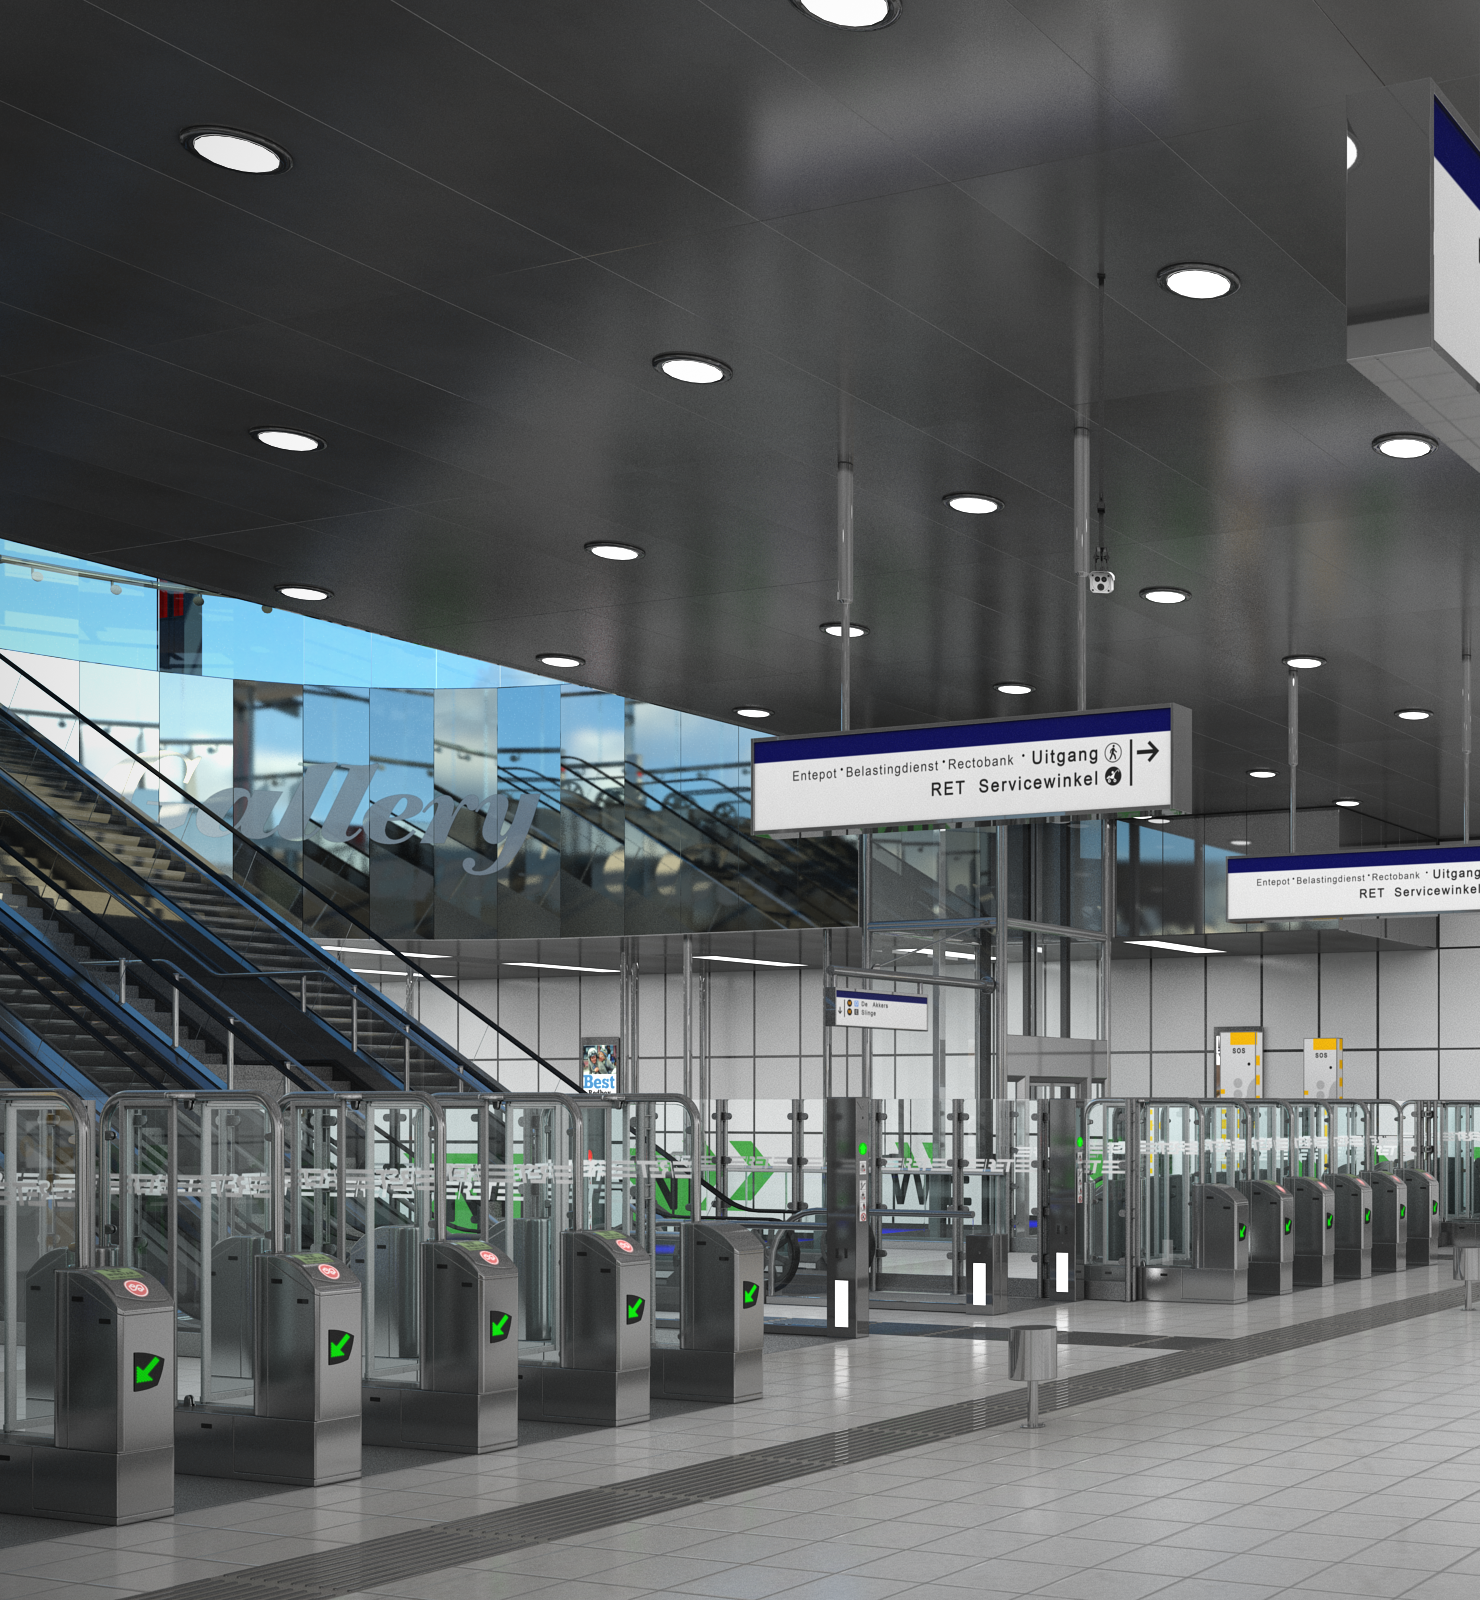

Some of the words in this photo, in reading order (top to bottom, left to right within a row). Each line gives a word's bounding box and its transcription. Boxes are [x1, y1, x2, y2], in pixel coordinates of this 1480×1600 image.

[792, 767, 837, 782] Entepot
[846, 759, 939, 778] Belastingdienst
[948, 753, 1014, 770] Rectobank
[1032, 746, 1099, 766] Uitgang
[931, 781, 965, 797] RET
[979, 771, 1098, 794] Servicewinkel
[1256, 876, 1290, 887] Entepot
[1296, 873, 1365, 885] Belastingdienst
[1372, 871, 1420, 881] Rectobank
[1432, 867, 1480, 881] Uitgang
[1359, 888, 1385, 899] RET
[1394, 884, 1480, 898] Servicewinkel
[583, 1075, 615, 1089] Best
